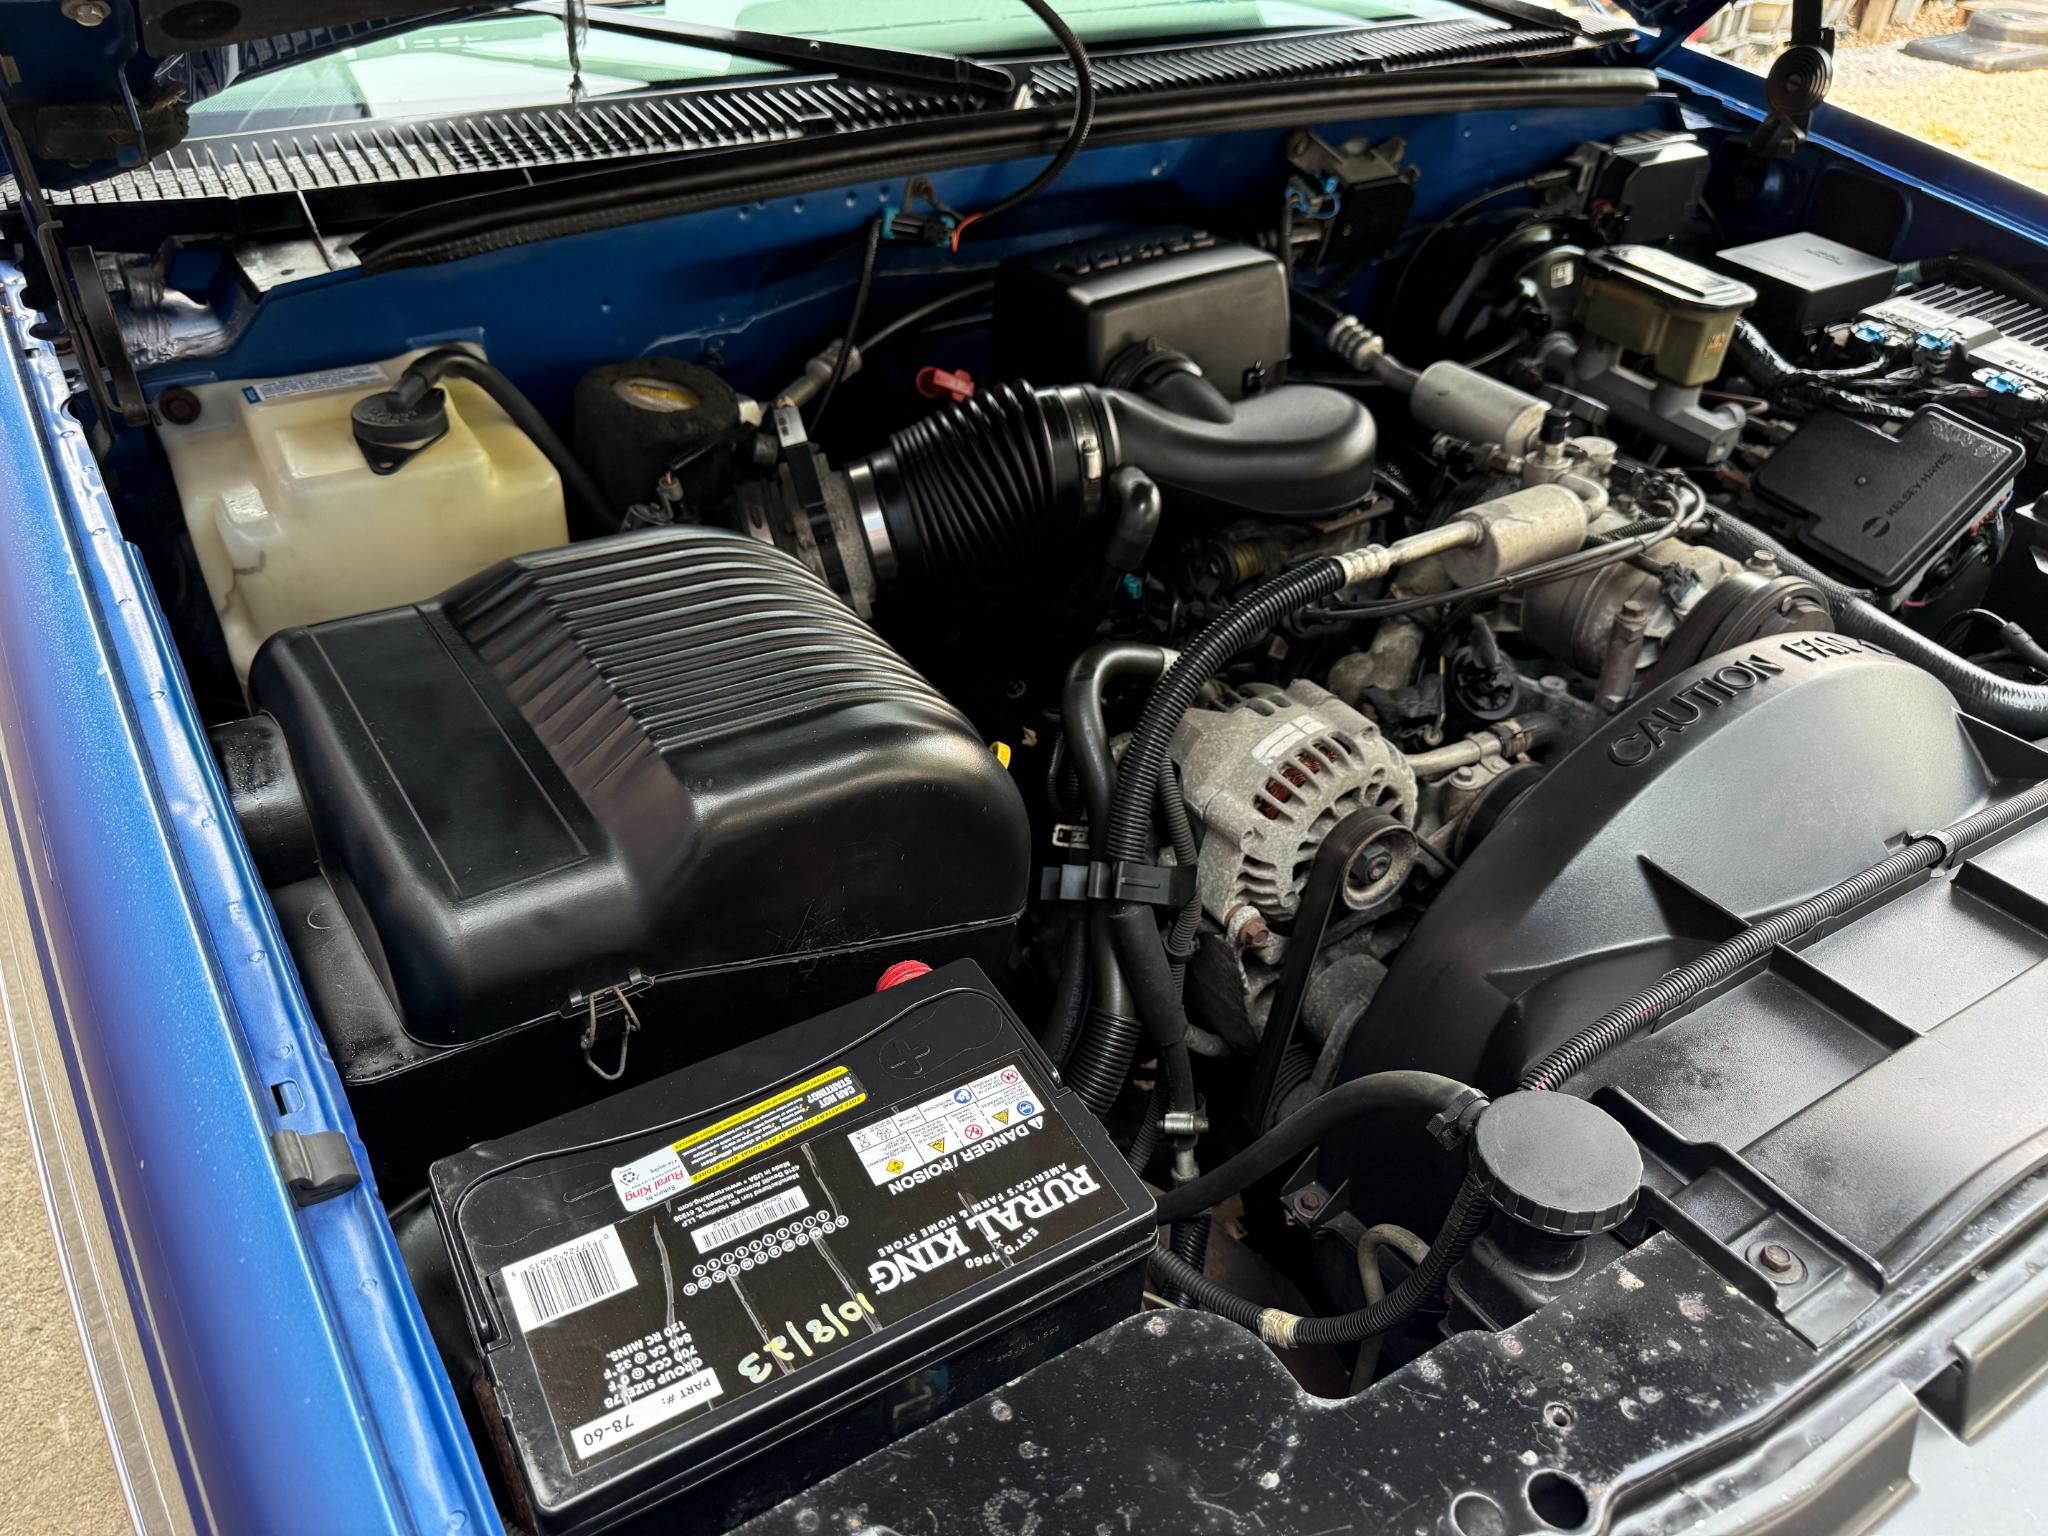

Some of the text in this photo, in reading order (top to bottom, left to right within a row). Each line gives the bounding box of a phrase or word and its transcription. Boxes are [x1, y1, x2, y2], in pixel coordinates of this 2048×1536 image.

[1607, 653, 1785, 767] CAUTION
[805, 1075, 853, 1104] STARTING?
[816, 1084, 856, 1109] CAR NOT
[776, 1131, 787, 1140] AT
[786, 1118, 815, 1135] TESTING
[739, 1143, 763, 1158] RURAL
[763, 1136, 778, 1146] ALL
[958, 1122, 1031, 1163] DANGER
[720, 1155, 739, 1167] KING
[652, 1168, 684, 1190] Rural
[676, 1159, 791, 1212] Made in USA www.ruralking.com
[733, 1179, 762, 1196] Avenue,
[752, 1171, 800, 1196] Manufactured
[1004, 1161, 1070, 1198] AMERICA'S
[623, 1183, 651, 1203] King
[644, 1184, 675, 1202] Return to
[702, 1191, 734, 1209] Mattoon,
[727, 1197, 741, 1207] RK
[759, 1194, 782, 1208] Serial
[969, 1191, 1005, 1214] FARM
[694, 1205, 703, 1213] IL
[694, 1201, 729, 1221] Holdings,
[745, 1203, 761, 1214] No:
[680, 1216, 696, 1227] LLP
[866, 1163, 1101, 1294] RURAL KING
[918, 1214, 957, 1238] HOME
[876, 1232, 918, 1258] STORE
[964, 1226, 1040, 1269] EST'D 1960
[605, 1318, 687, 1364] 120 RC MINS.
[666, 1330, 693, 1350] 840
[737, 1291, 875, 1386] 10/8/23
[631, 1350, 648, 1366] @
[647, 1342, 668, 1359] CA
[671, 1342, 698, 1362] 700
[629, 1365, 646, 1382] @
[644, 1353, 673, 1375] CCA
[655, 1354, 704, 1385] GROUP
[602, 1392, 622, 1410] 78
[659, 1375, 712, 1408] PART #:
[580, 1412, 635, 1448] 78-60
